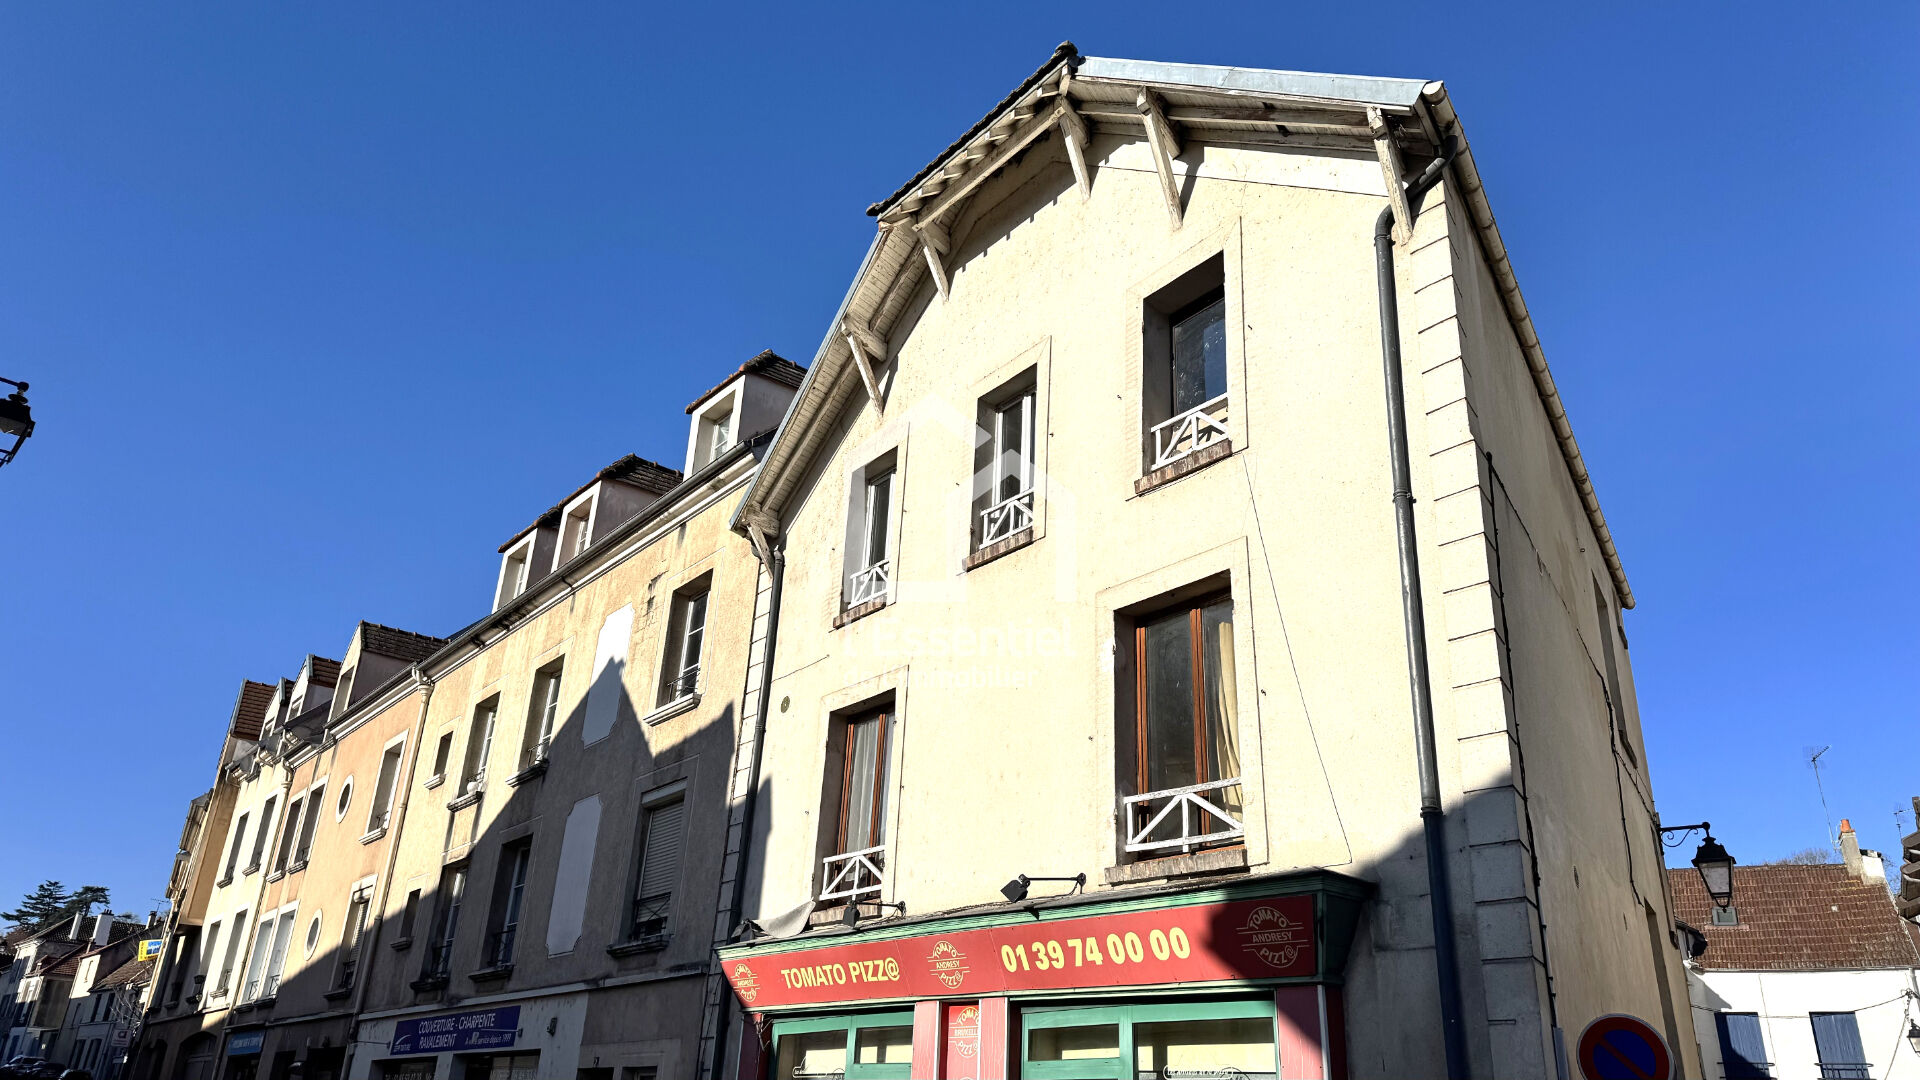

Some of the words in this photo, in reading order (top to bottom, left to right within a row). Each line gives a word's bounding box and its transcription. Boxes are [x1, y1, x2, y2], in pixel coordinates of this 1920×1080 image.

[1250, 909, 1287, 930] TOMATO
[1252, 931, 1292, 943] ANDRESY
[935, 943, 957, 959] TOMATO
[1001, 944, 1031, 973] 01
[1032, 940, 1064, 971] 39
[1067, 937, 1103, 967] 74
[1106, 931, 1144, 965] 00
[1149, 926, 1191, 961] 00
[1260, 945, 1296, 964] PIZZ@
[781, 963, 847, 989] TOMATO
[848, 957, 900, 983] PIZZ@
[936, 960, 960, 969] ANDRESY
[418, 1017, 456, 1034] COUVERTURE
[458, 1013, 496, 1030] CHARPENTE
[419, 1034, 457, 1049] RAVALEMENT
